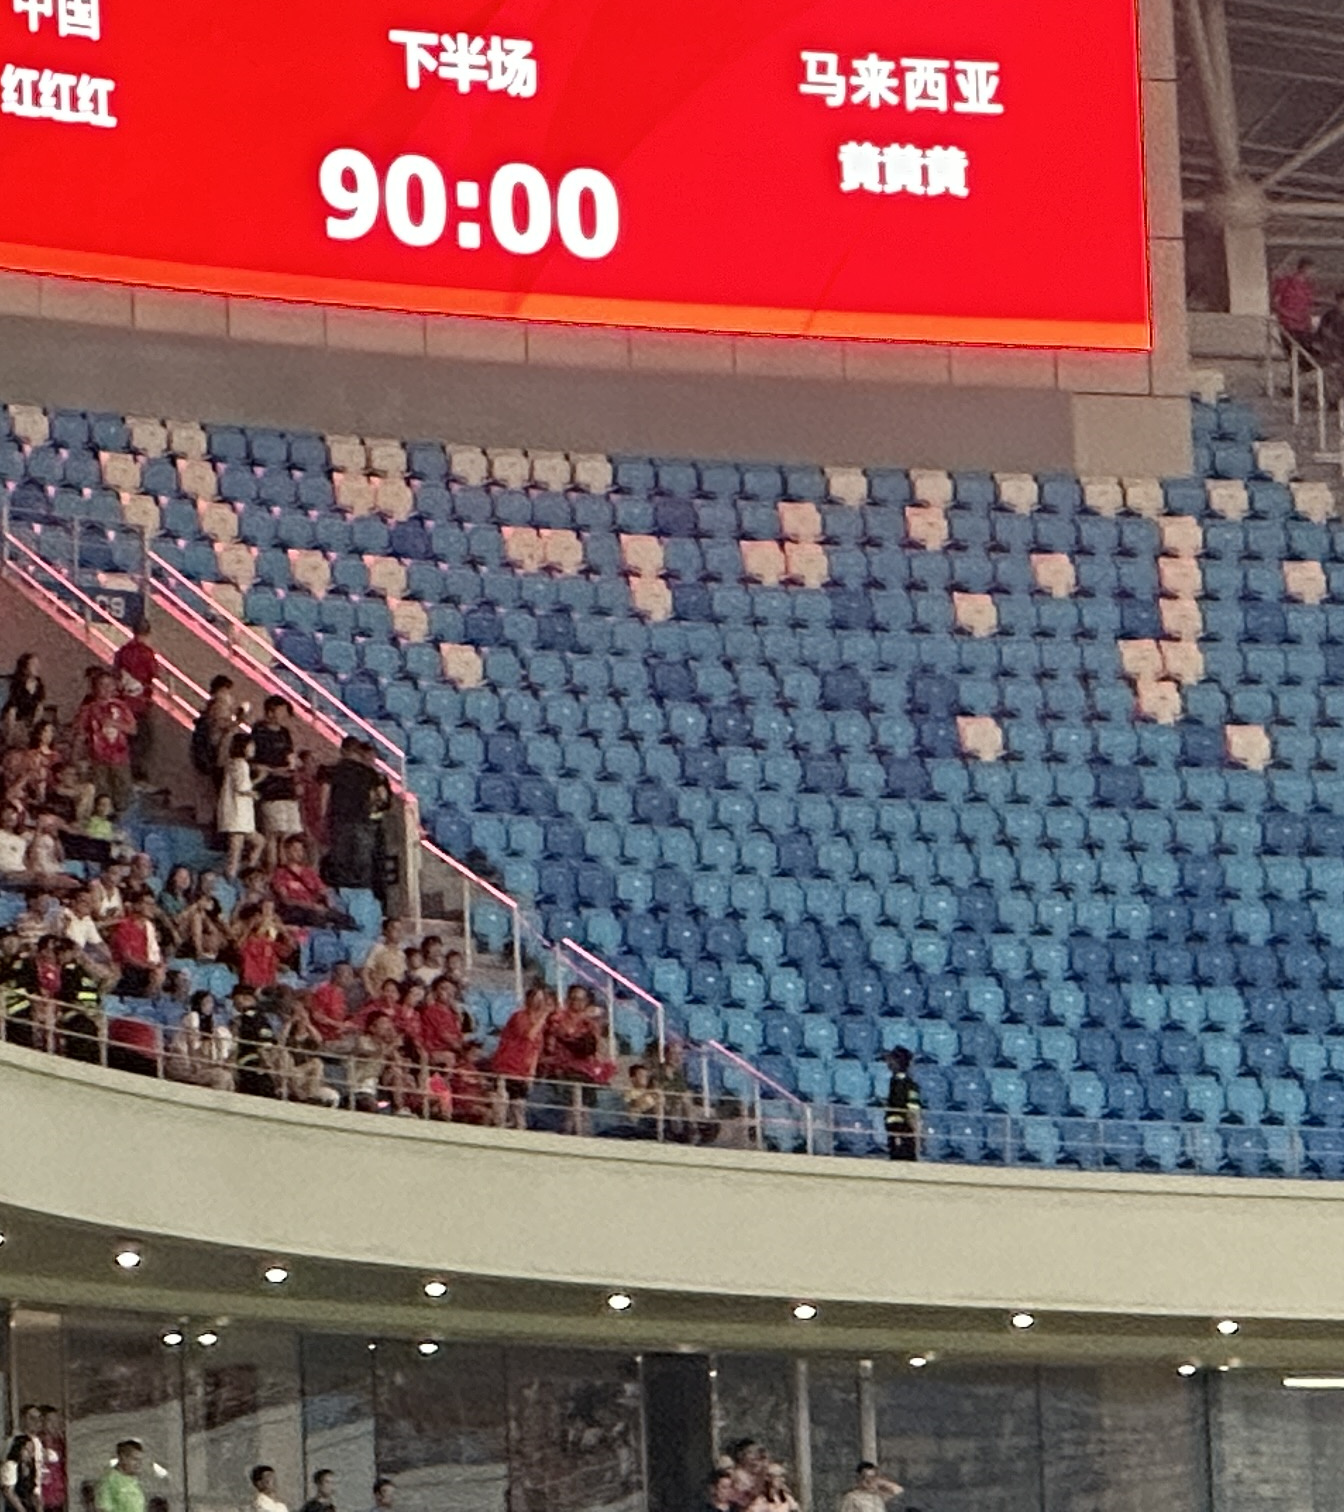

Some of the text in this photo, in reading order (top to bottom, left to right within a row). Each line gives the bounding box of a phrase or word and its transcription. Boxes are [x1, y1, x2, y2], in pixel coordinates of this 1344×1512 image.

[0, 63, 118, 129] 红红红
[387, 28, 538, 99] 下半场
[798, 50, 1005, 115] 马来西亚
[837, 140, 970, 198] 黄黄黄
[318, 147, 620, 260] 90:00
